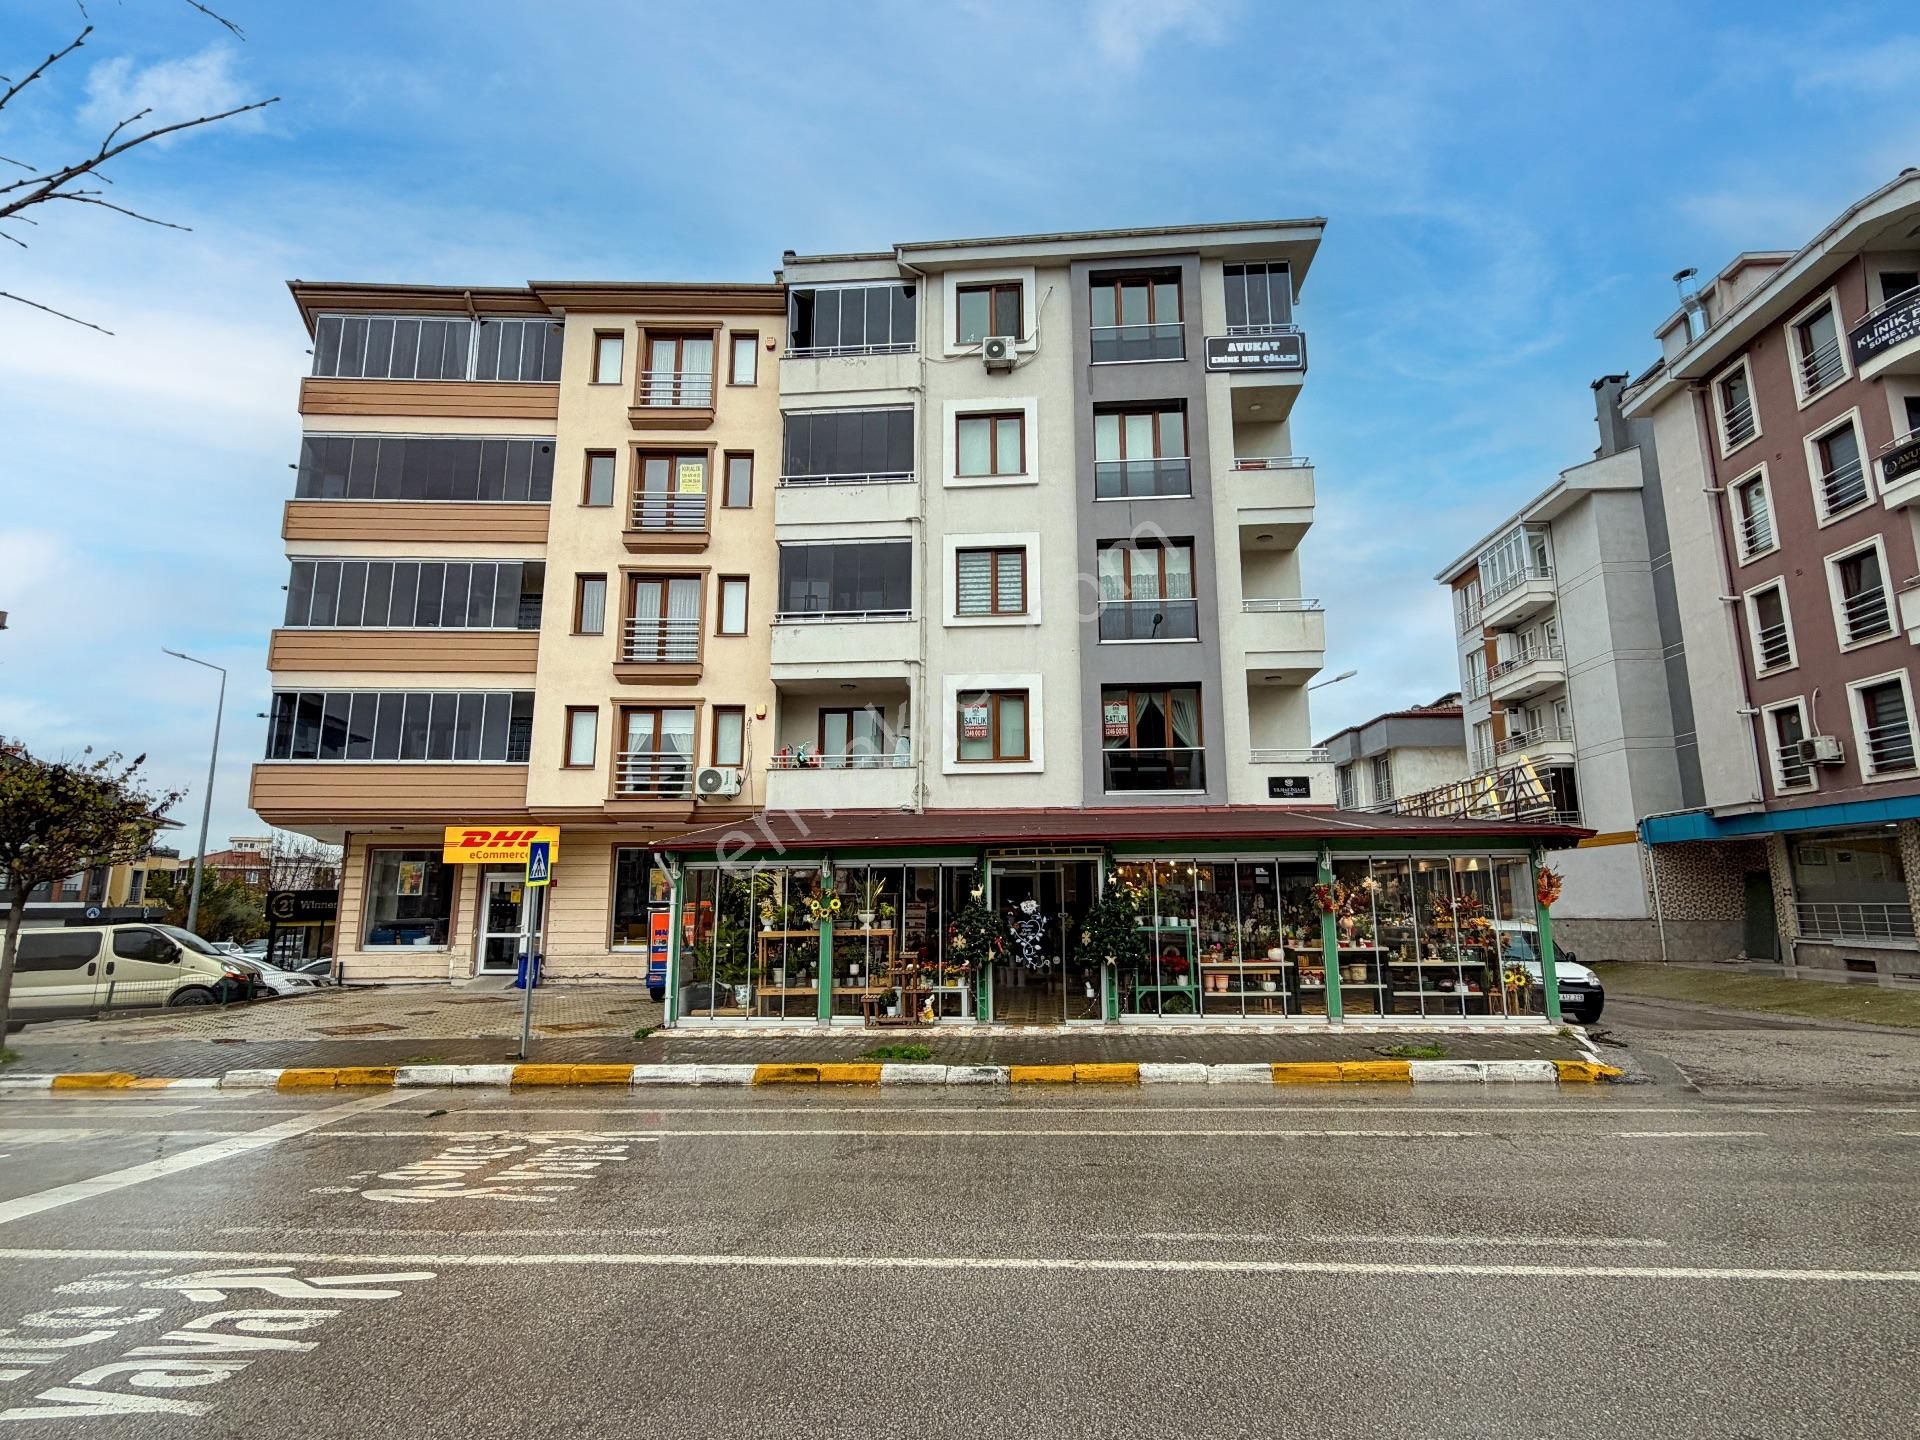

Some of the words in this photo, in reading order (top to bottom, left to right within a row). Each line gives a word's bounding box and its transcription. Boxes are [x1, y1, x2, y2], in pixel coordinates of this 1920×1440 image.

[1228, 341, 1280, 352] AVUKAT
[964, 716, 987, 725] SATILIK
[1105, 714, 1127, 723] SATILIK
[460, 831, 539, 848] DHL
